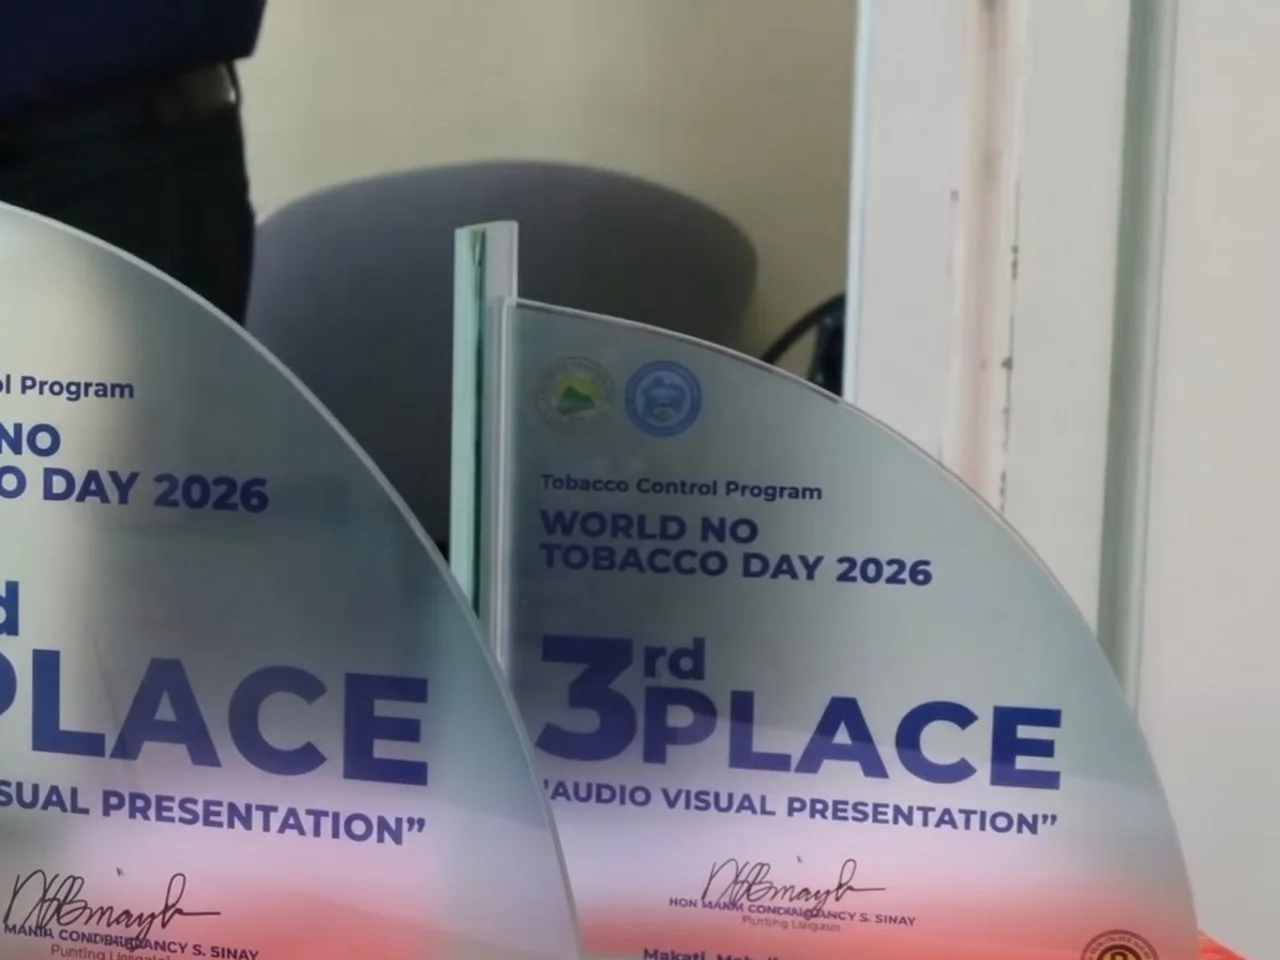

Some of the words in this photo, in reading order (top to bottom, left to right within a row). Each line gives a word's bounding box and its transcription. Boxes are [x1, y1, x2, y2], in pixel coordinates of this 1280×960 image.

[20, 375, 135, 402] Program
[42, 466, 140, 505] DAY
[153, 473, 269, 514] 2026
[540, 474, 629, 493] Tobacco
[636, 477, 718, 497] Control
[725, 480, 823, 502] Program
[540, 509, 686, 541] WORLD
[700, 516, 759, 544] NO
[540, 543, 728, 577] TOBACCO
[742, 552, 825, 581] DAY
[836, 556, 933, 586] 2026
[642, 686, 1062, 790] PLACE
[661, 787, 776, 817] VISUAL
[875, 914, 916, 927] SINAY
